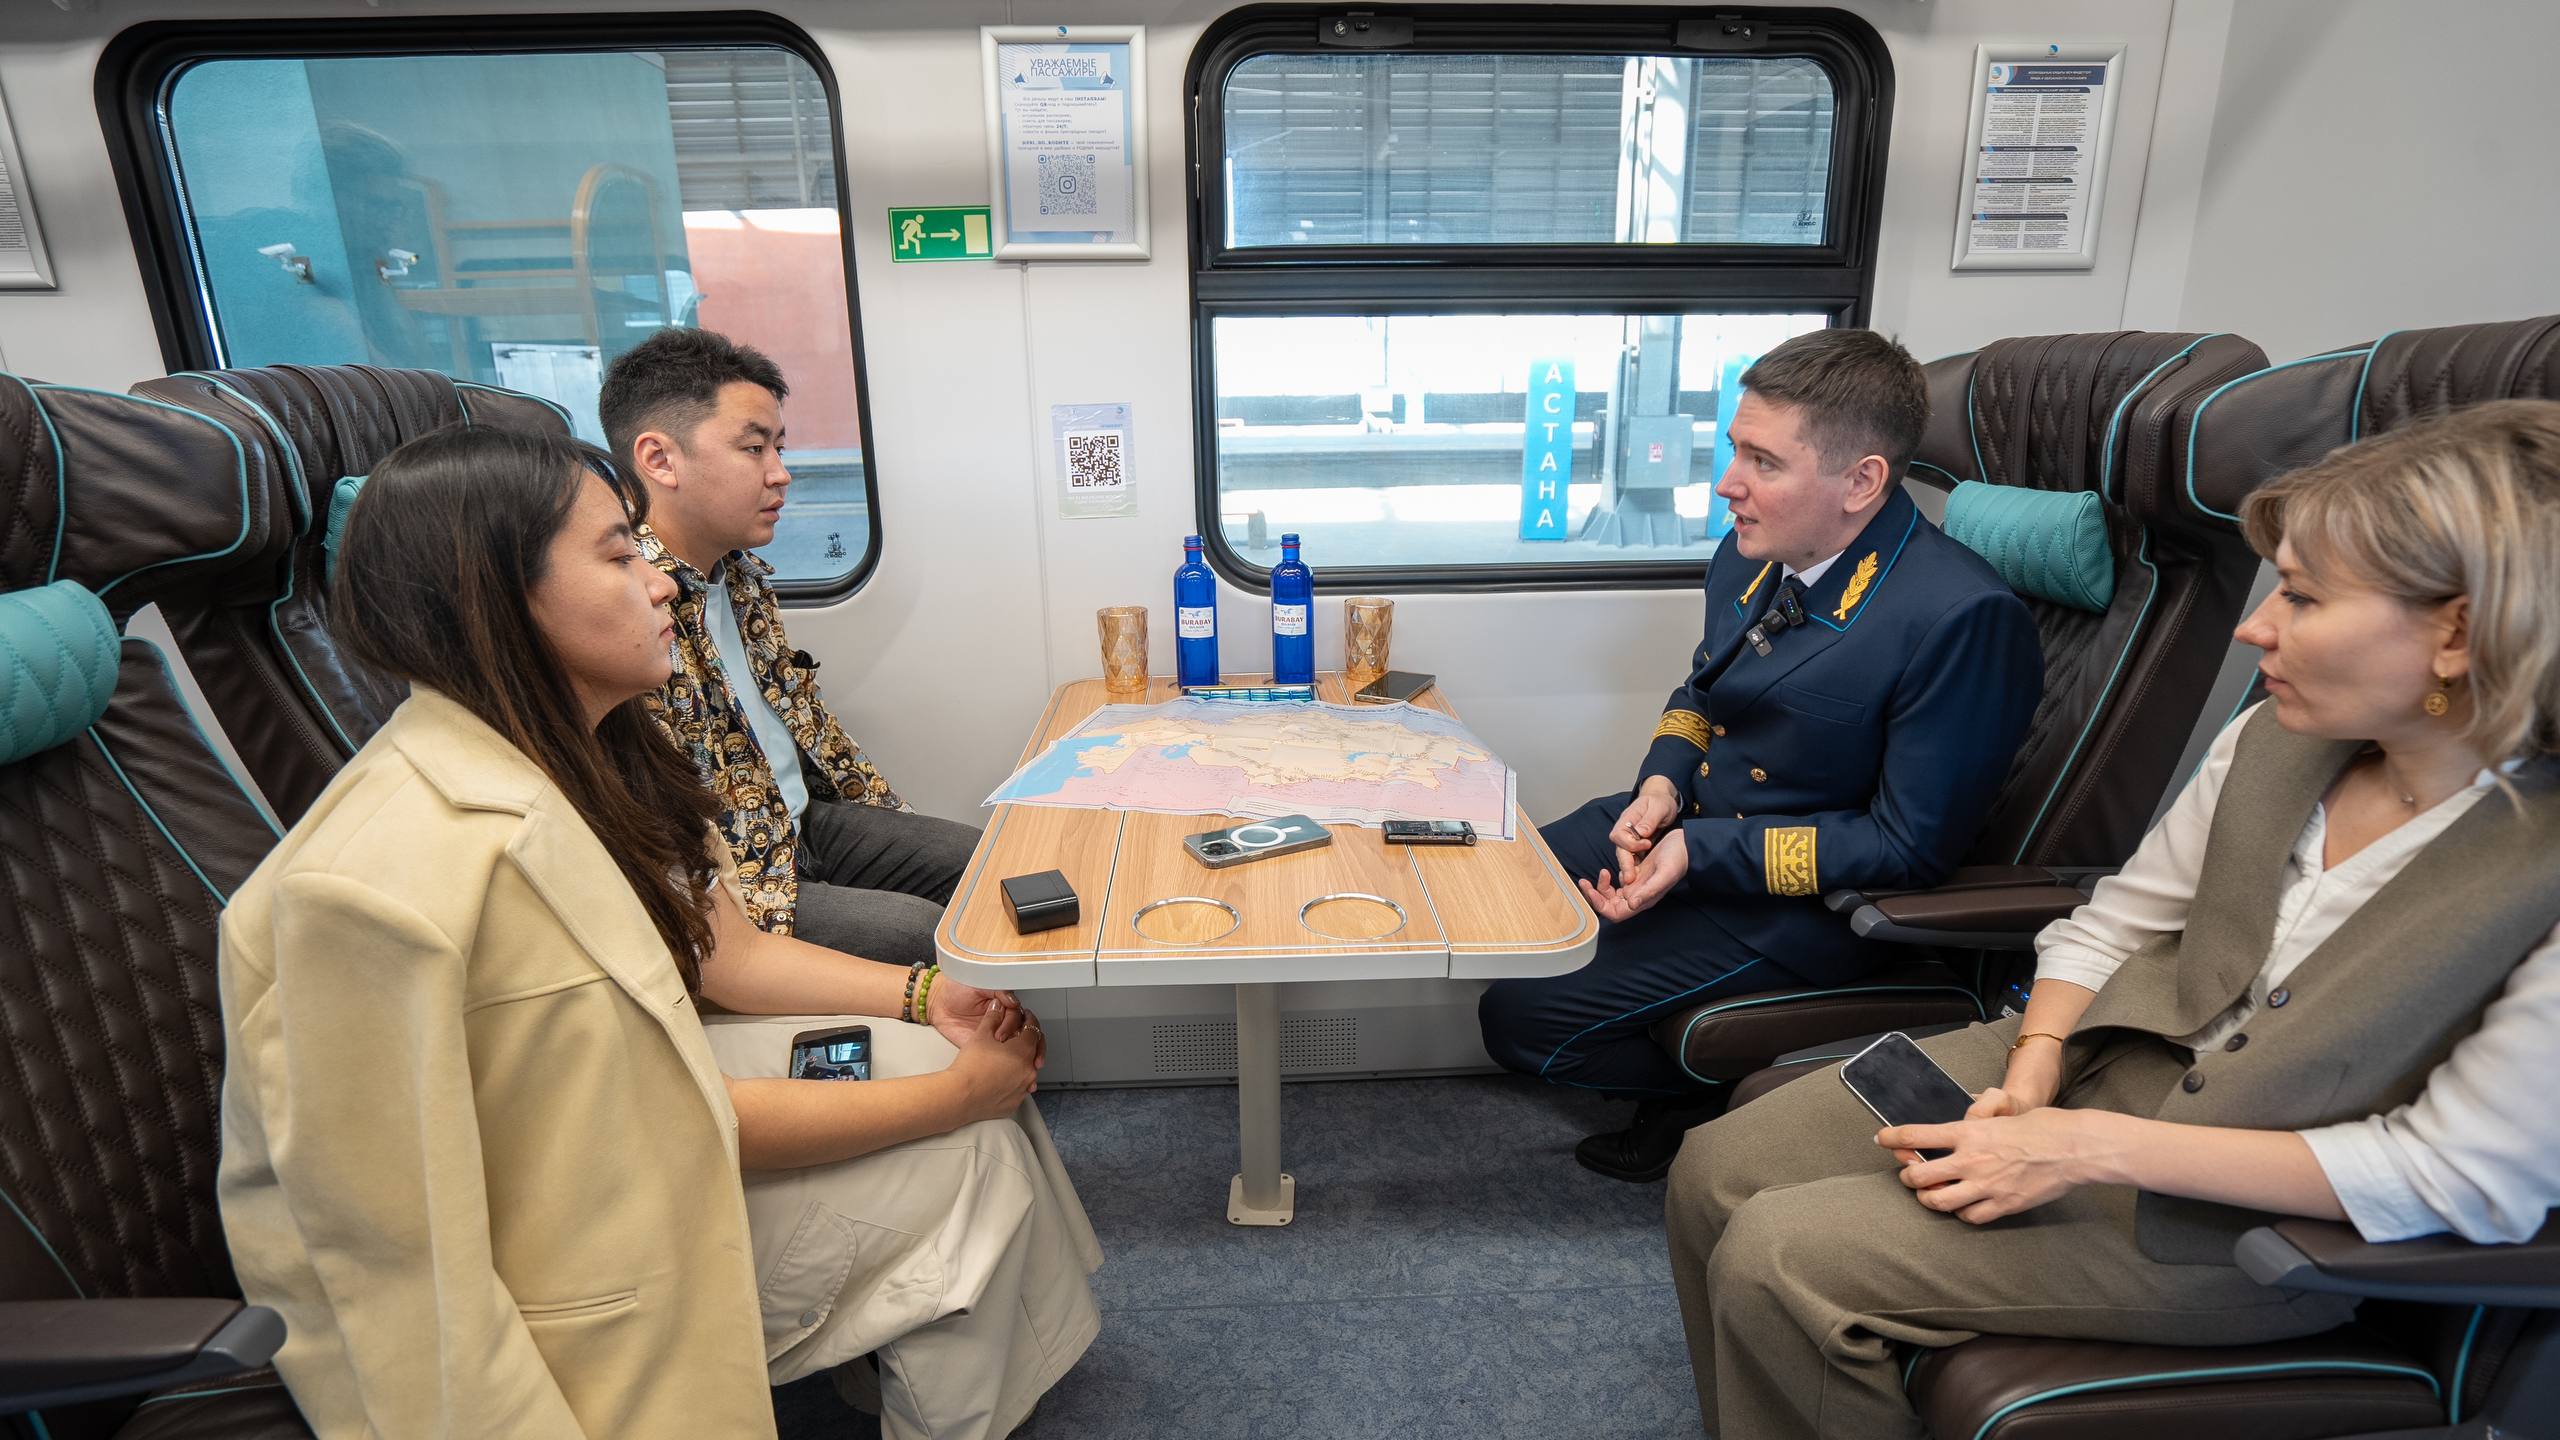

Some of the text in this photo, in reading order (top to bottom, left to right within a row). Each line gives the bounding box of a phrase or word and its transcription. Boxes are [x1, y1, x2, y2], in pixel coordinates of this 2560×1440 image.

[1030, 58, 1097, 67] УВАЖАЕМЫЕ
[1030, 67, 1097, 77] ПАССАЖИРЫ
[1537, 362, 1563, 529] АСТАНА
